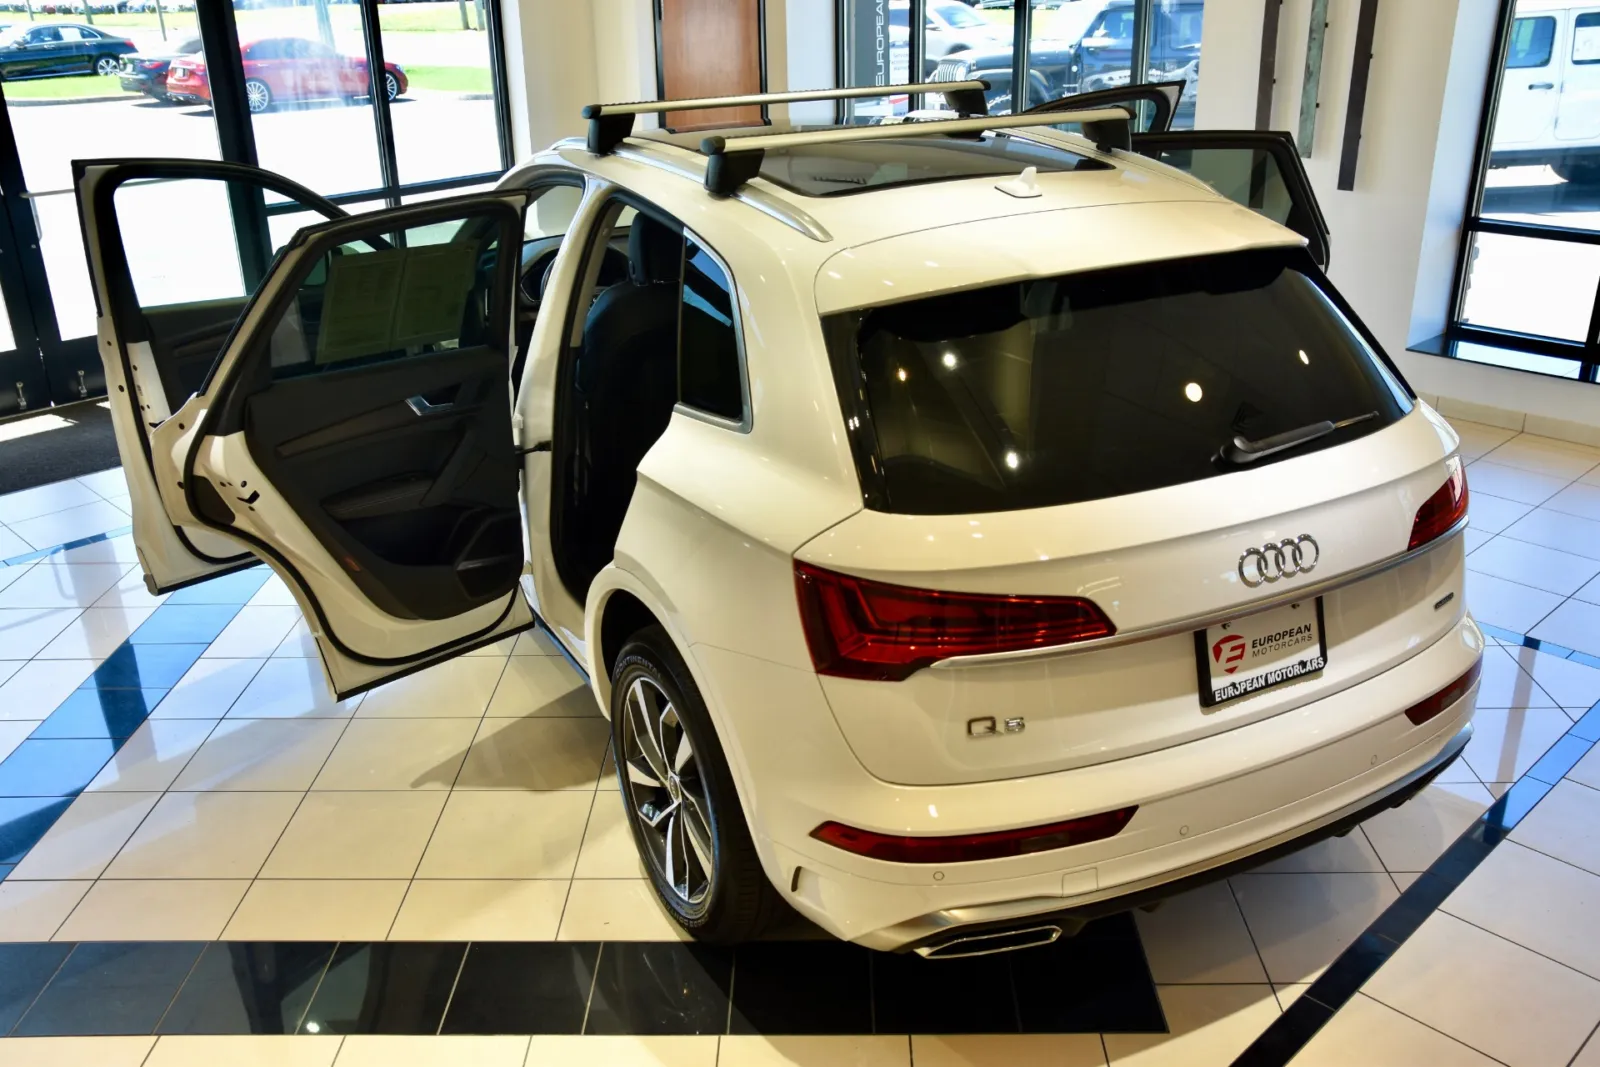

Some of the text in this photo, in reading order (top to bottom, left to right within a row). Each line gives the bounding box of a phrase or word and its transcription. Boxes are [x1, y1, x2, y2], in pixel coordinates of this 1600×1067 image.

[1251, 623, 1312, 649] EUROPEAN
[1252, 633, 1313, 658] MOTORCARS
[1214, 675, 1266, 702] EUROPEAN
[966, 715, 1026, 738] Q5
